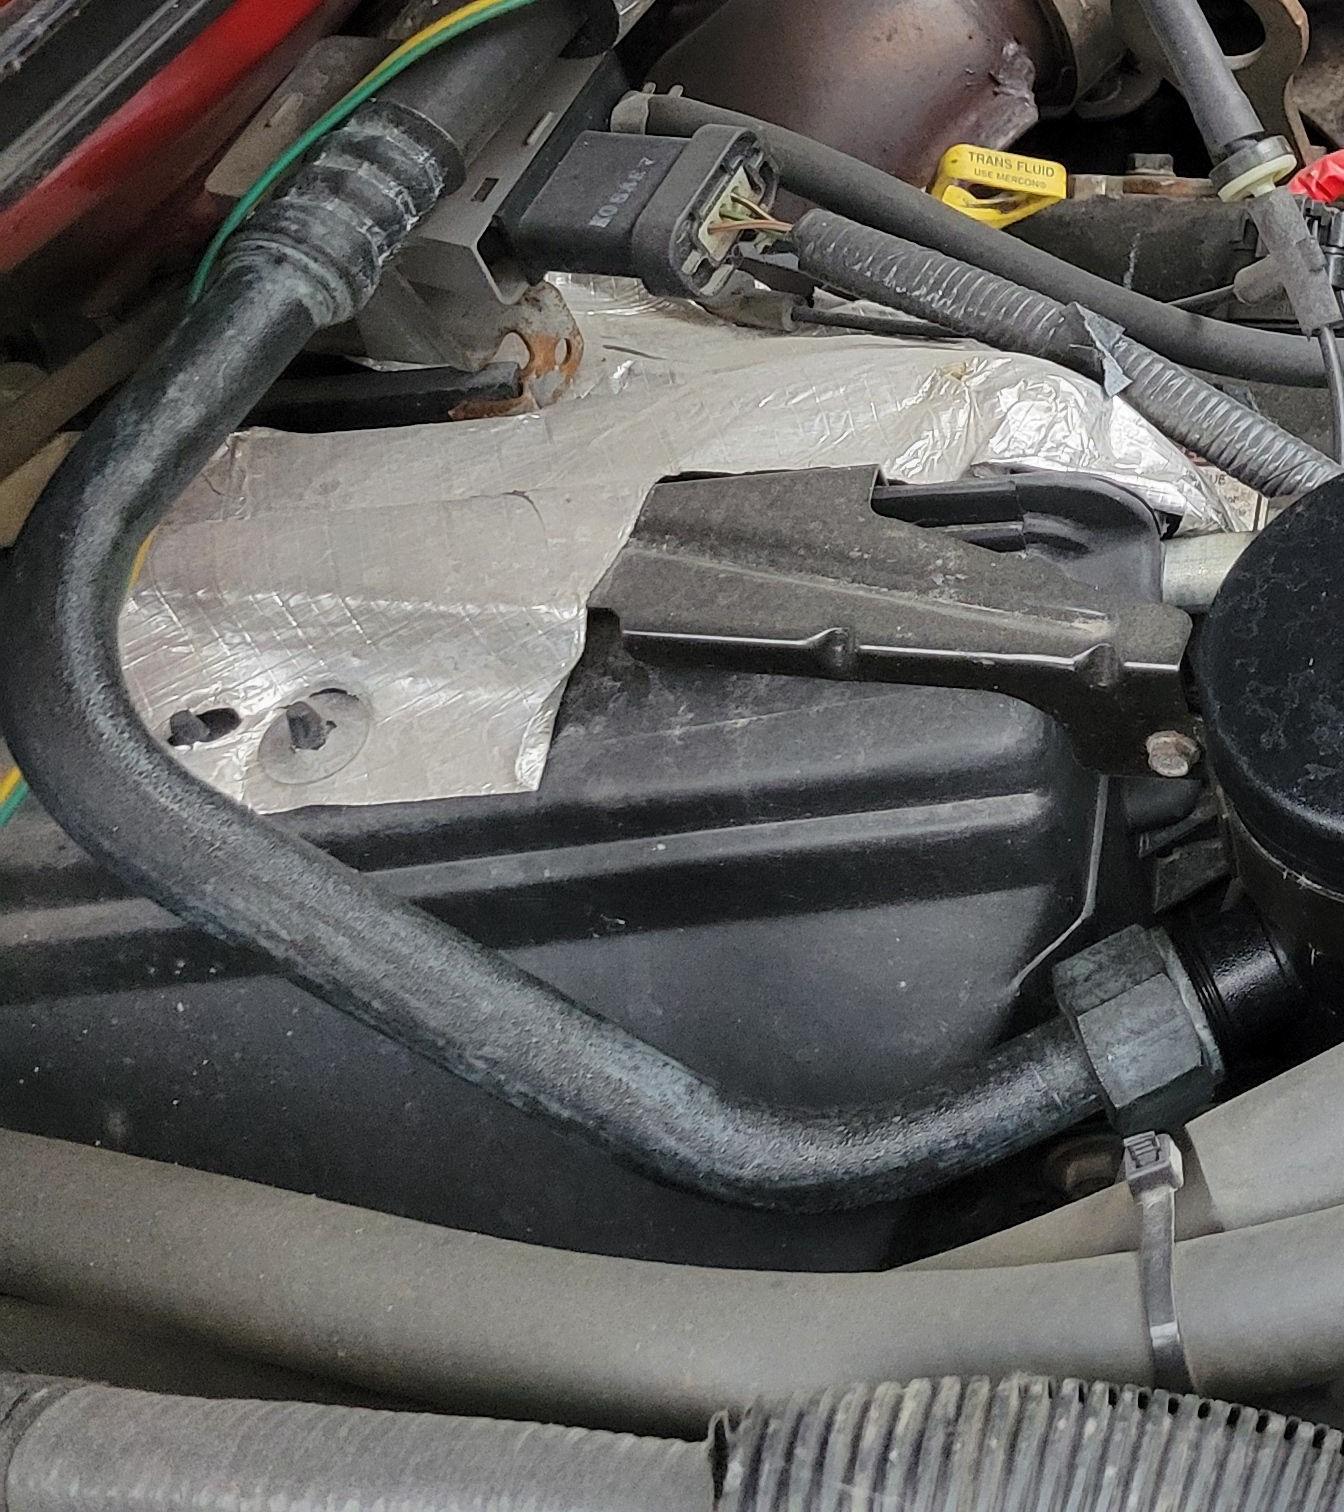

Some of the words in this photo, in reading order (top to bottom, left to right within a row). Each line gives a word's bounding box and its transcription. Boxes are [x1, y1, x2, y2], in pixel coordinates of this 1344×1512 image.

[968, 151, 1013, 169] TRANS
[1016, 160, 1055, 178] FLUID
[974, 168, 994, 178] USE
